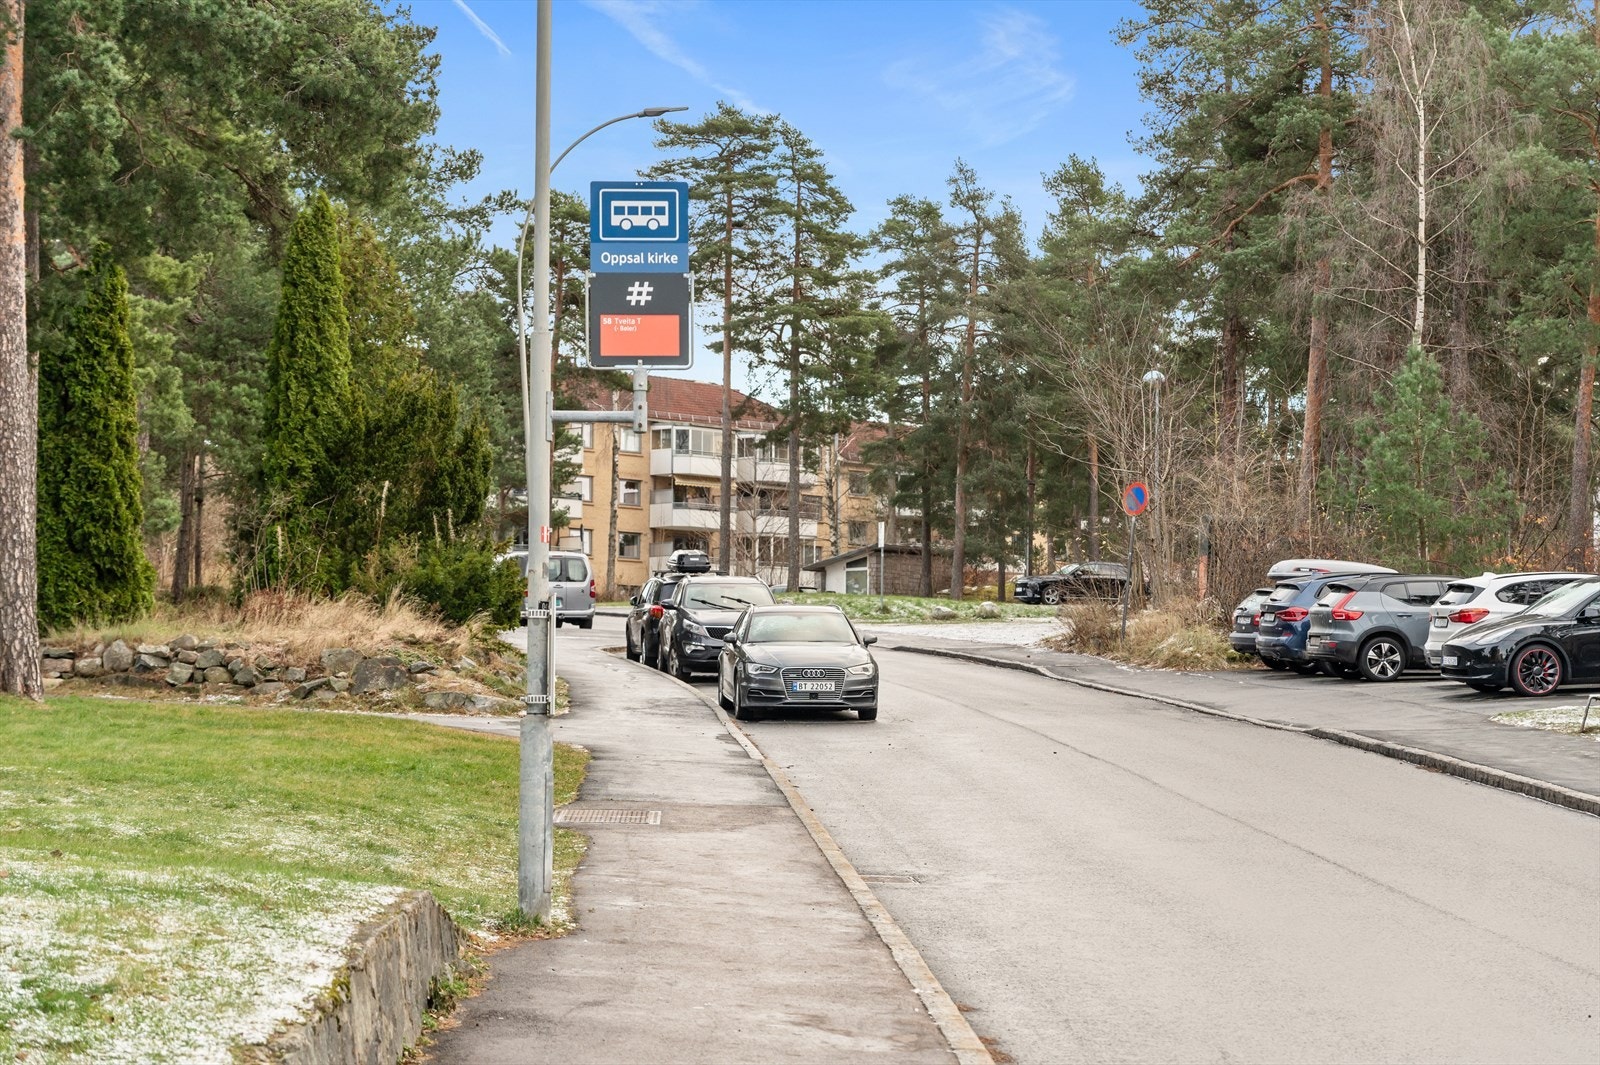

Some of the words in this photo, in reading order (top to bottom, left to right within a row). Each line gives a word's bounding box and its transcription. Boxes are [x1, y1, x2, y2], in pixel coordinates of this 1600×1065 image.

[600, 251, 645, 266] Oppsal
[647, 252, 679, 264] kirke
[602, 317, 612, 325] 58
[614, 317, 636, 325] Tveita
